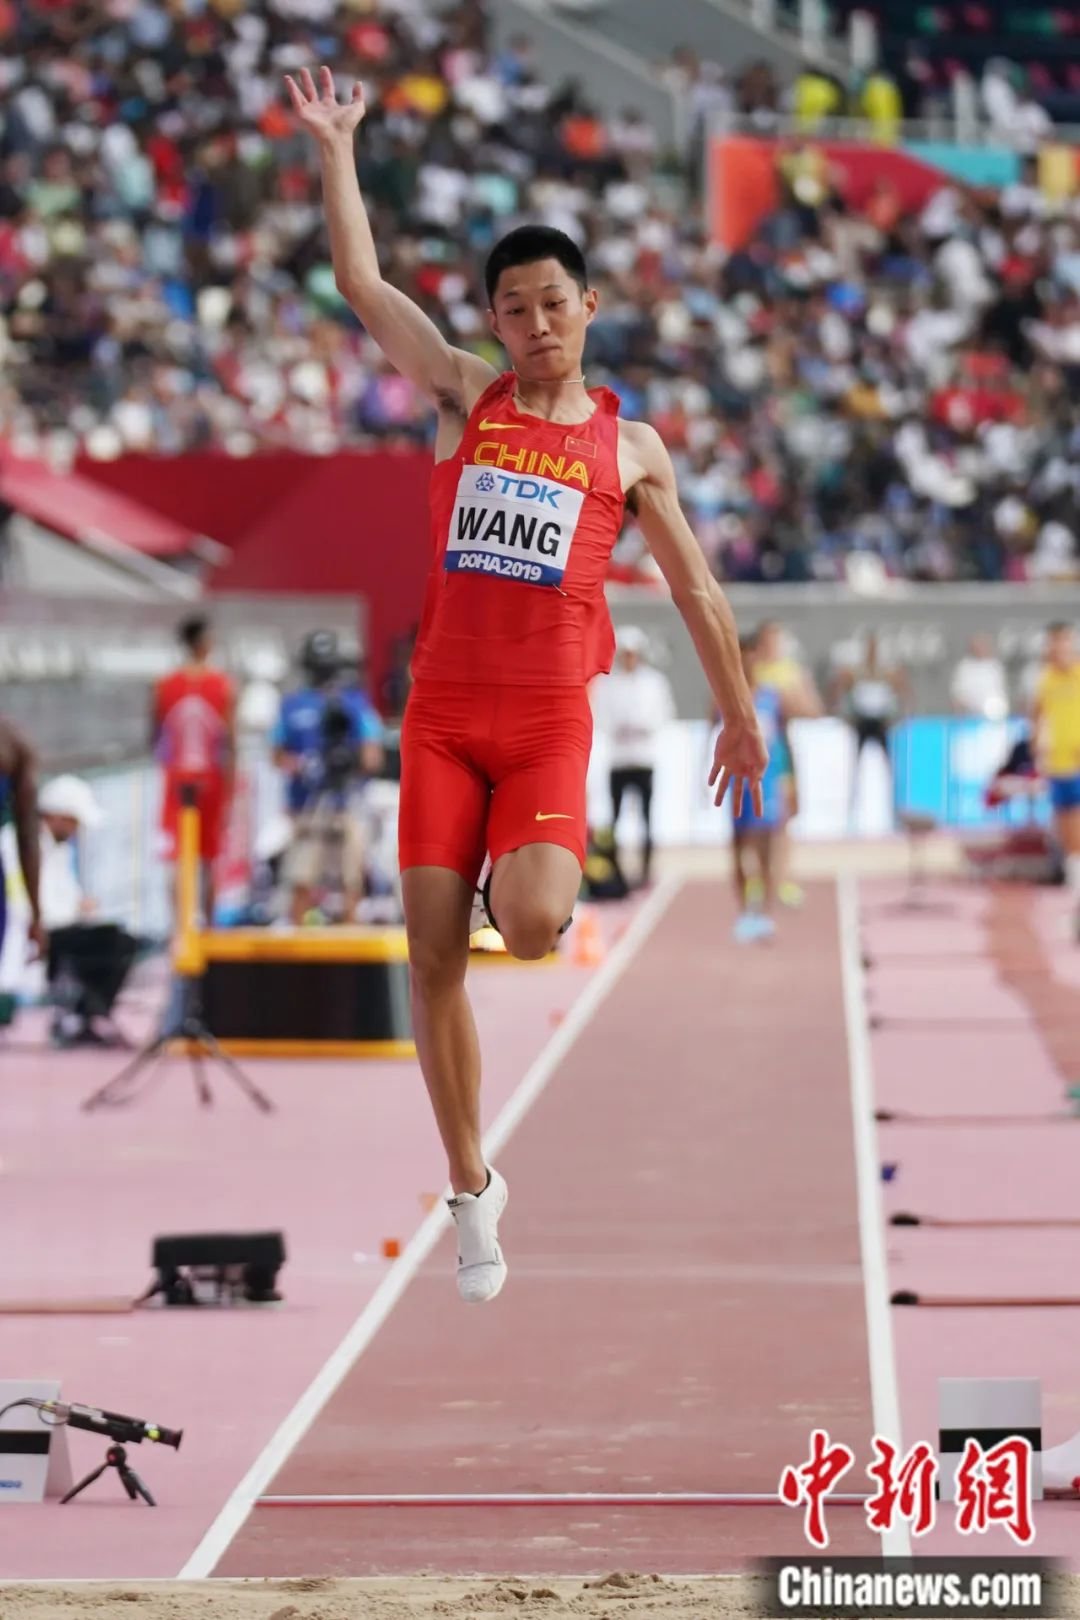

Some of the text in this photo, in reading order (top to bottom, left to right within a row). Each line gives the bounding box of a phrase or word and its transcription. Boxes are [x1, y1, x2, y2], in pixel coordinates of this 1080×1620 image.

[474, 442, 589, 488] CHINA
[497, 475, 563, 509] TDK
[457, 506, 561, 557] WANG
